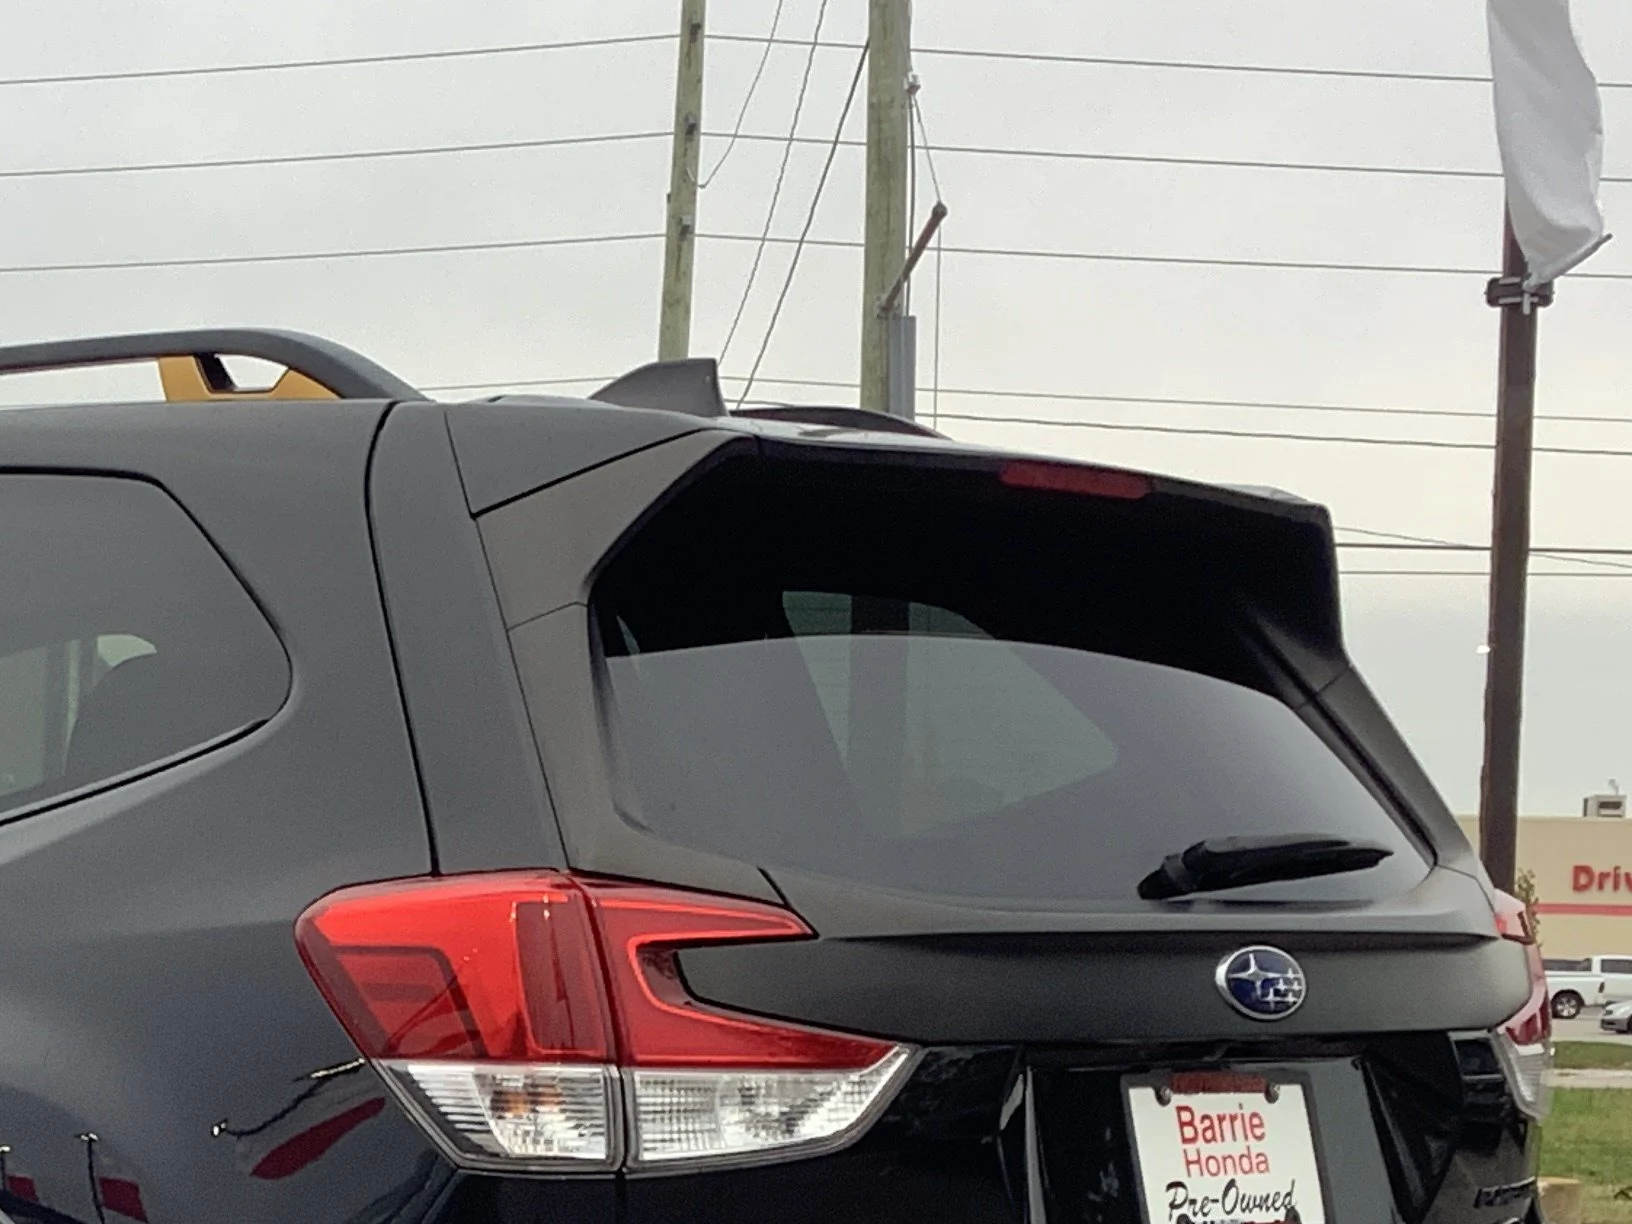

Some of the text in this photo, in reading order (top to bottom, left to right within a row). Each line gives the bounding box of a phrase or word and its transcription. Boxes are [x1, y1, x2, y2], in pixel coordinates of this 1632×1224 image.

[1175, 1103, 1266, 1145] Barrie
[1183, 1145, 1270, 1178] Honda
[1165, 1178, 1297, 1221] Pre-Owned
